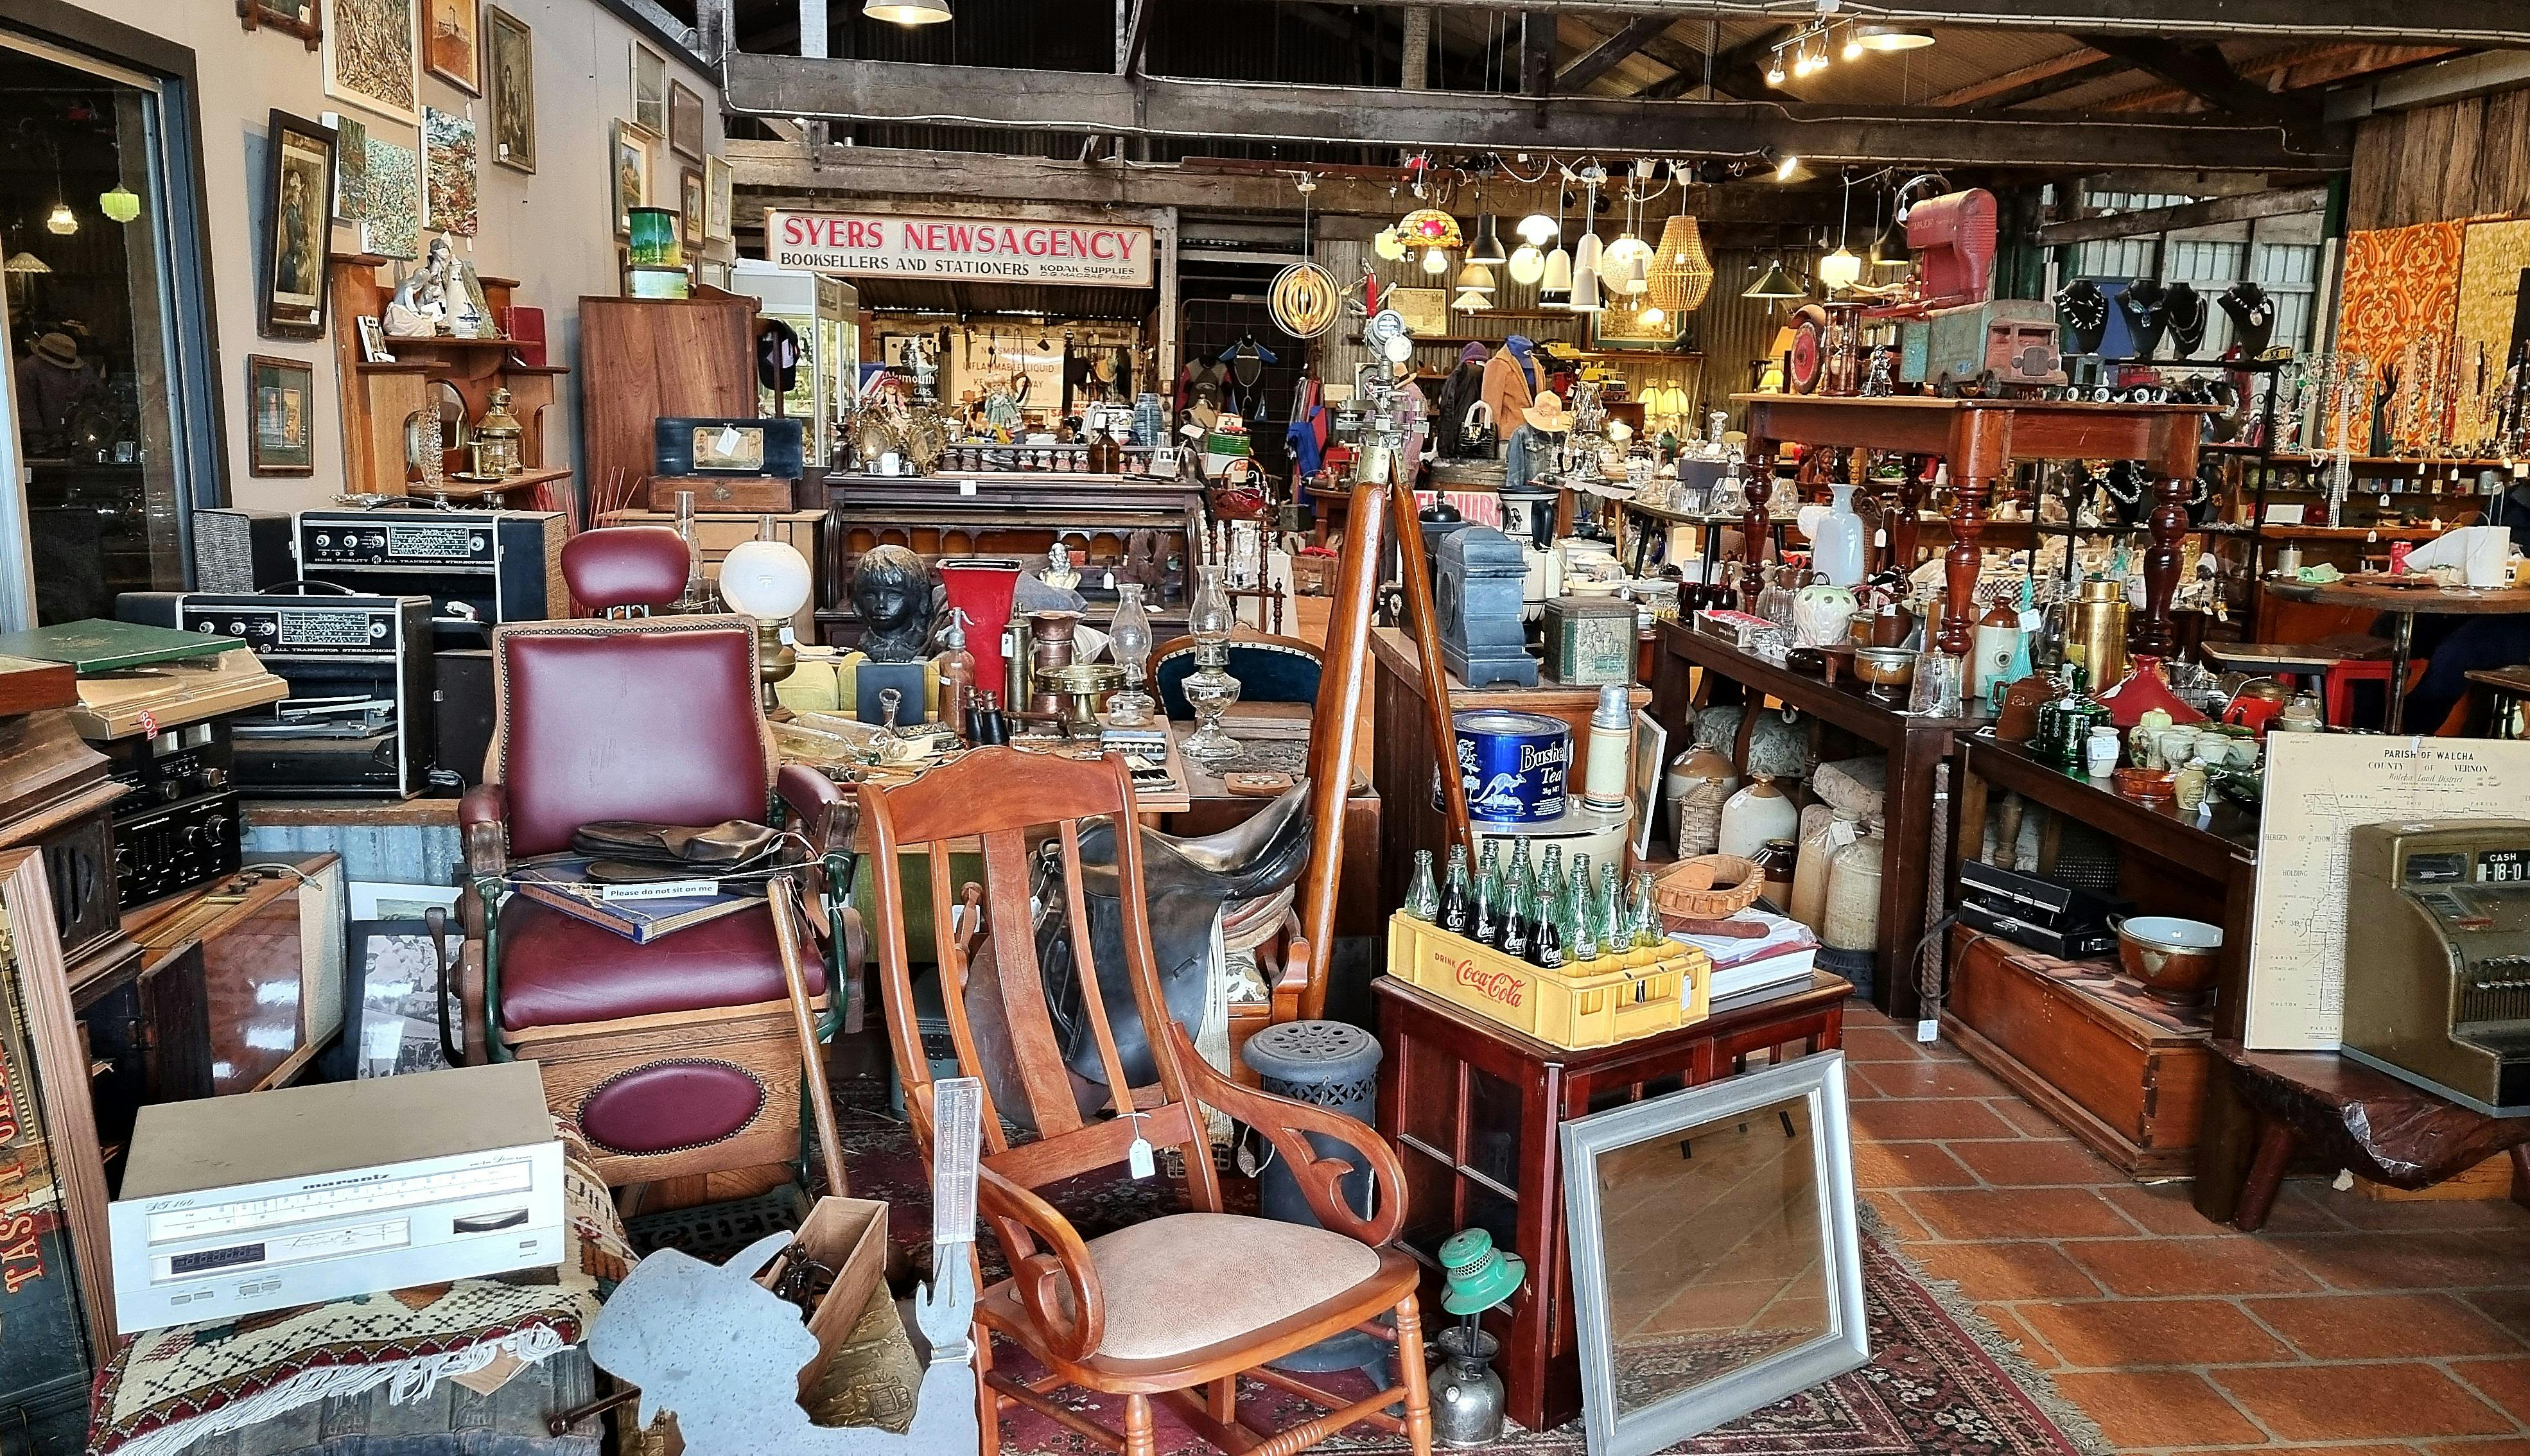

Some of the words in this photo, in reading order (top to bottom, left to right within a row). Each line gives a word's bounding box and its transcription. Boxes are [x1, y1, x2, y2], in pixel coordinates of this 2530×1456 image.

[783, 216, 884, 249] SYERS
[903, 222, 1140, 261] NEWSAGENCY
[781, 252, 888, 269] BOOKSELLERS
[896, 258, 927, 271] AND
[936, 259, 1029, 276] STATIONERS
[1040, 264, 1079, 273] KODAK
[1084, 266, 1135, 275] SUPPLIES
[997, 347, 1036, 356] SMOKING
[1027, 364, 1054, 372] LIQUID
[914, 387, 932, 395] CARS
[2384, 749, 2416, 759] PARISH
[2437, 752, 2474, 761] WALCHA
[2368, 761, 2404, 770] COUNTY
[2454, 764, 2488, 773] VERNON
[1541, 767, 1562, 784] Tea
[2417, 773, 2436, 782] Land
[2438, 774, 2463, 783] District
[2490, 853, 2517, 862] CASH
[672, 885, 683, 894] sit
[1435, 952, 1456, 968] DRINK
[1456, 959, 1526, 1008] Coca-Cola
[302, 1174, 391, 1190] marantz
